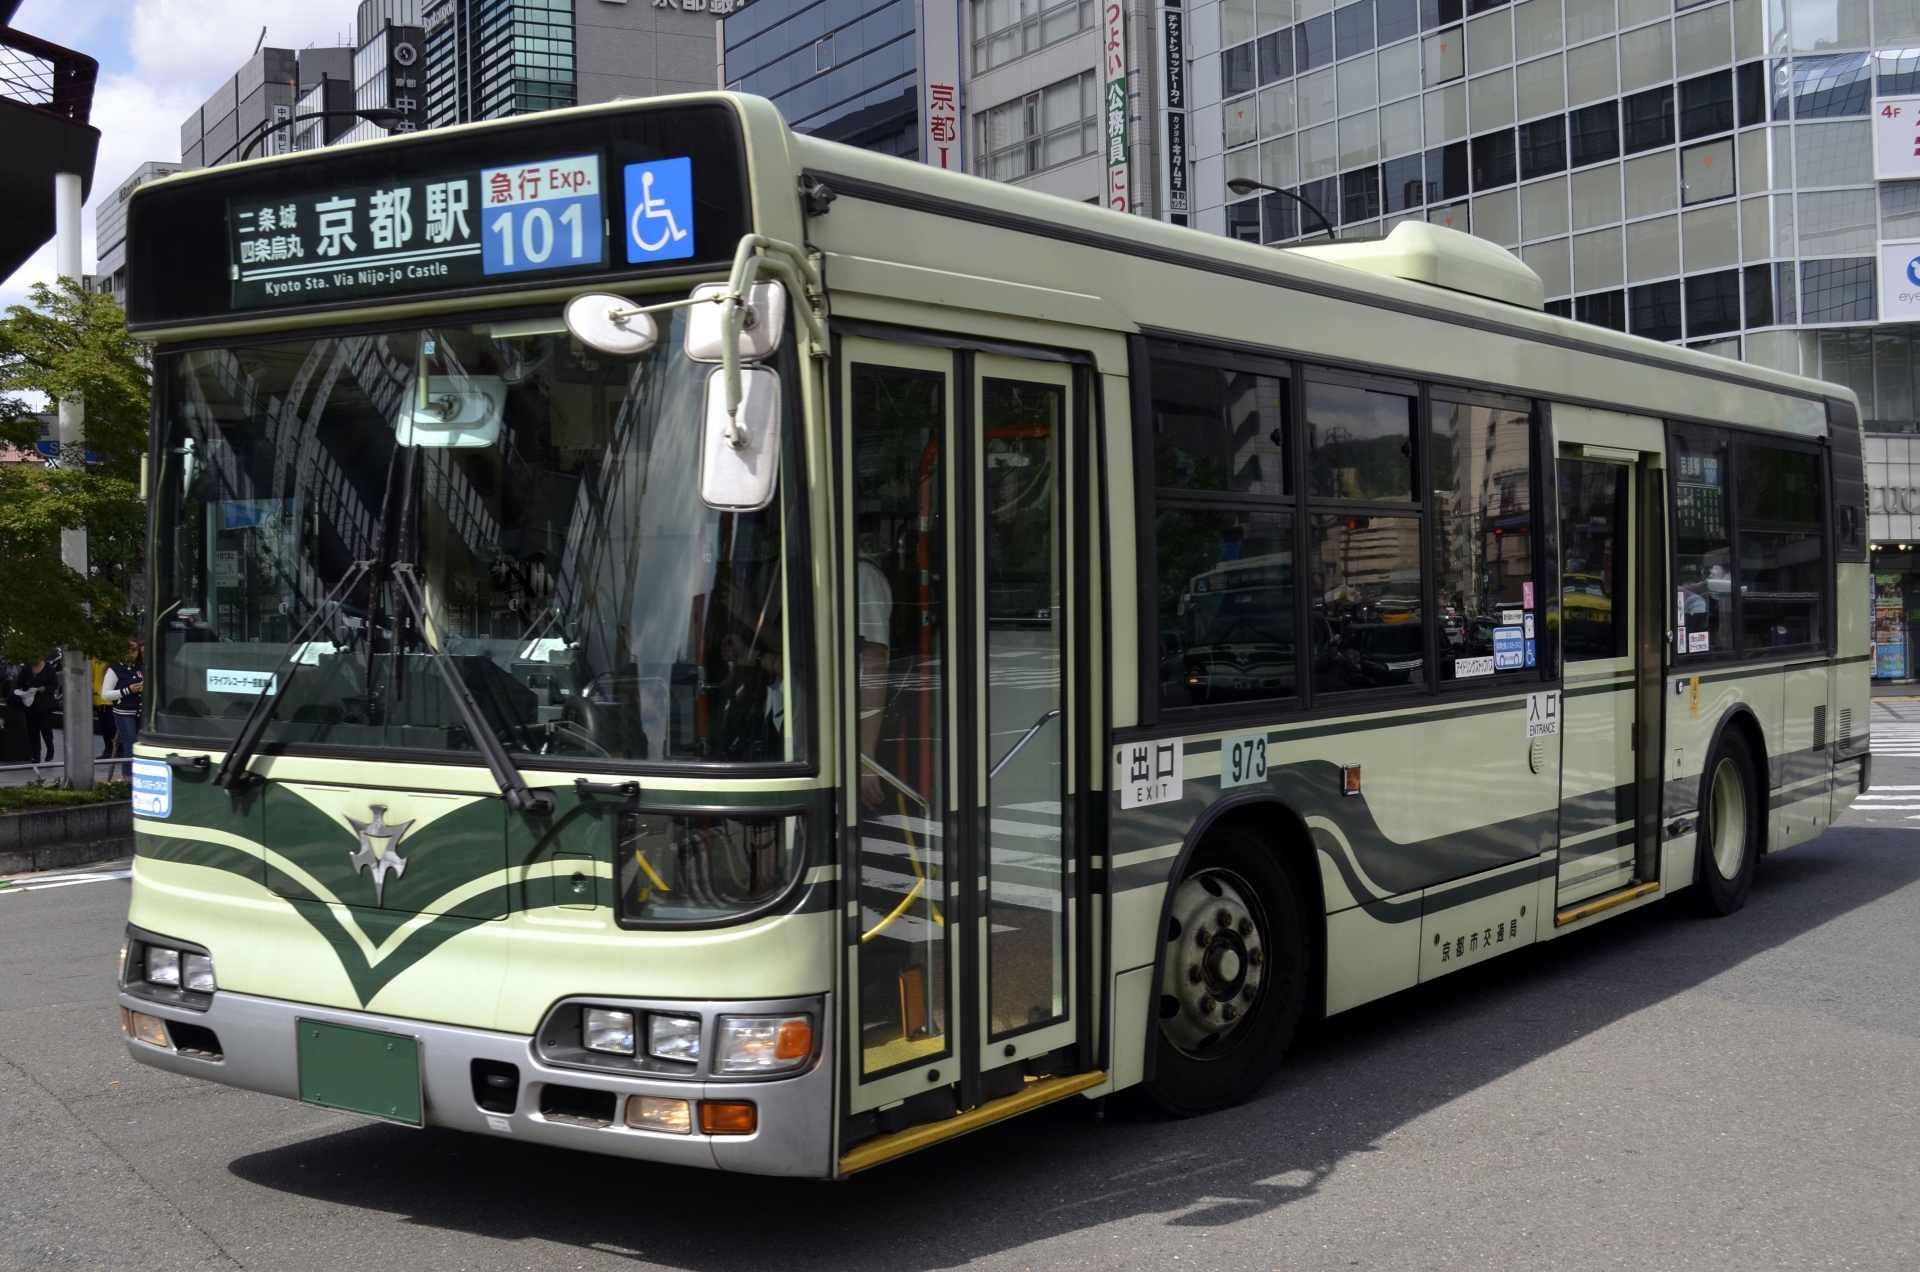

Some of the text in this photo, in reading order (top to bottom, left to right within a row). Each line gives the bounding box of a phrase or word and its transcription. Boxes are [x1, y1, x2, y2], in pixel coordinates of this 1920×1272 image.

[1881, 105, 1902, 118] 4F
[1173, 116, 1183, 188] カメラのキタムラ
[490, 168, 591, 203] 急行 Exp.
[239, 204, 298, 233] 二条城
[315, 179, 470, 257] 京都駅
[491, 203, 583, 266] 101
[240, 234, 304, 264] 四条烏丸
[265, 262, 449, 297] Kyoto Sta. Via Nijo-jo Castle
[1530, 693, 1557, 721] 入口
[1530, 722, 1556, 736] ENTRANCE
[1131, 743, 1175, 784] 出口
[1232, 738, 1267, 783] 973
[1137, 784, 1167, 802] EXIT
[1442, 919, 1517, 963] 京都市交通局
